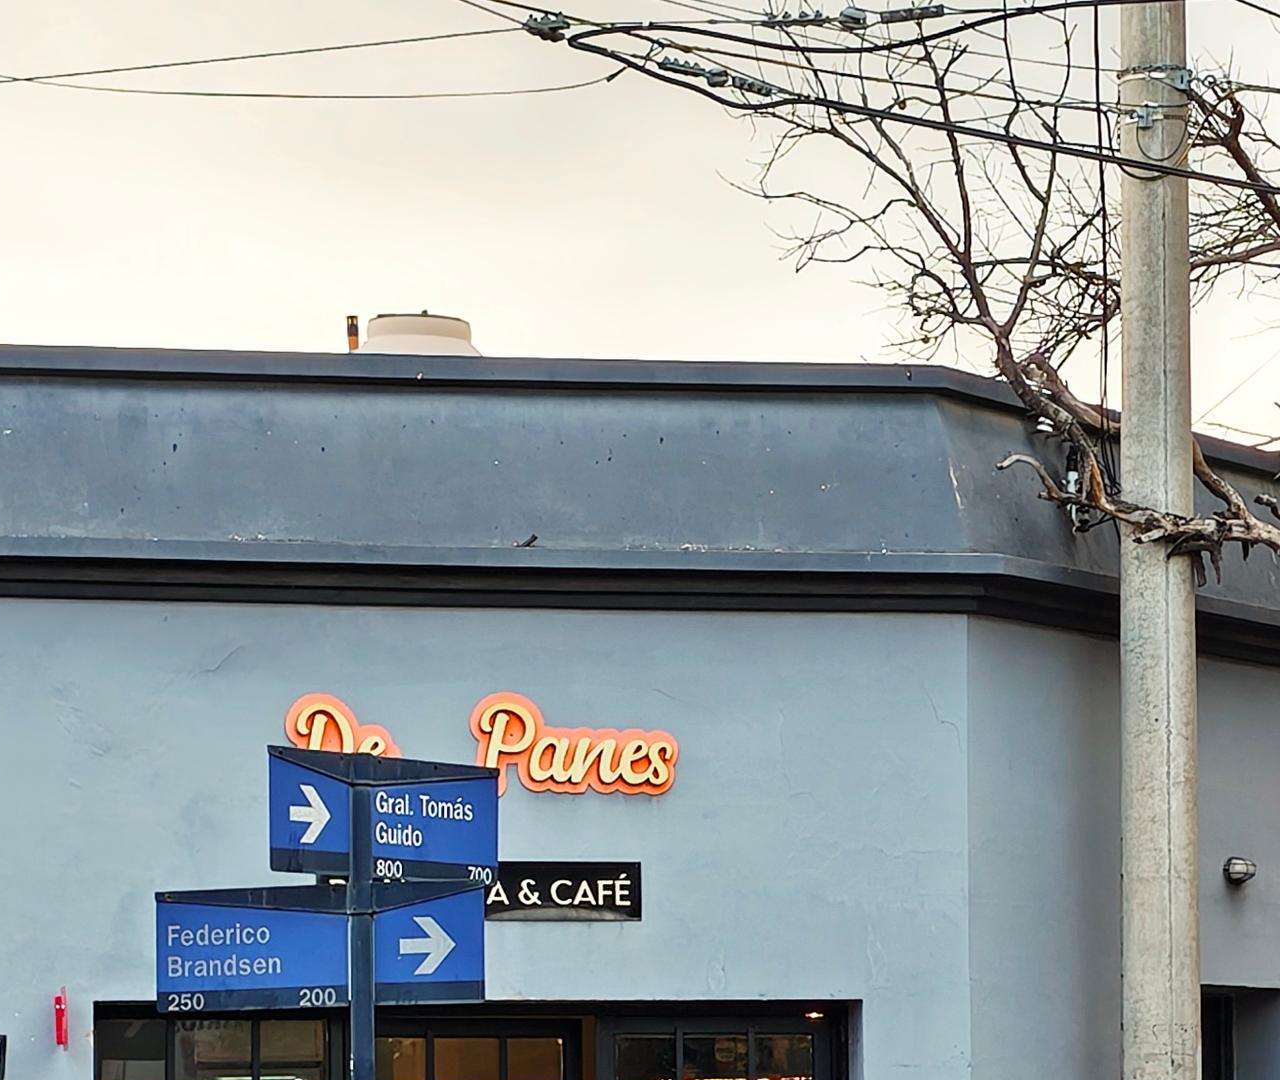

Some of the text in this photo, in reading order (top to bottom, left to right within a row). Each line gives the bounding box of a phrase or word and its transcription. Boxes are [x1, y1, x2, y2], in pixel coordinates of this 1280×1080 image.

[479, 702, 674, 786] Panes
[375, 790, 473, 821] Gral. Tomás
[375, 821, 423, 847] Guido
[376, 859, 492, 885] 800 700
[518, 878, 542, 905] &
[550, 873, 632, 906] CAFÉ
[166, 922, 271, 947] Federico
[166, 954, 282, 978] Brandsen
[167, 988, 336, 1011] 250 200
